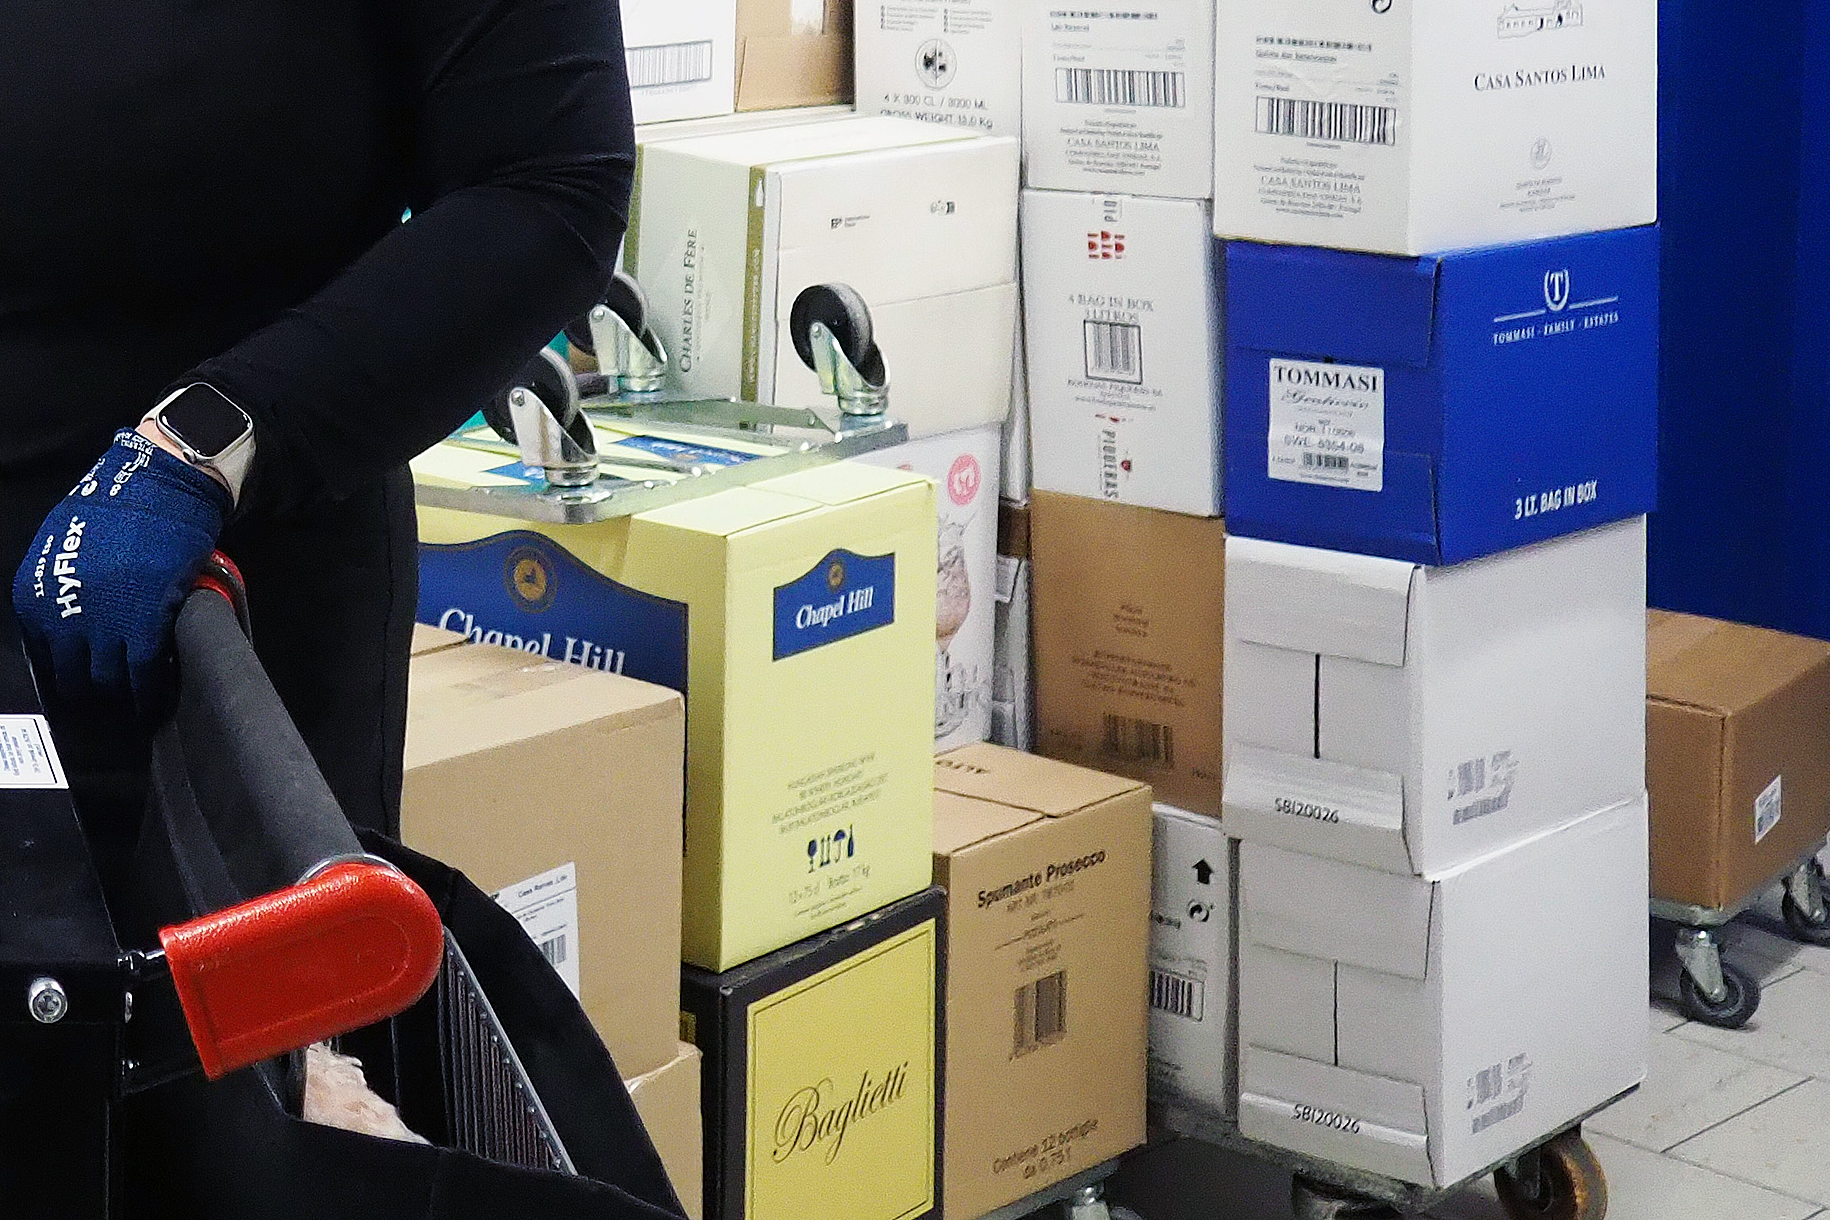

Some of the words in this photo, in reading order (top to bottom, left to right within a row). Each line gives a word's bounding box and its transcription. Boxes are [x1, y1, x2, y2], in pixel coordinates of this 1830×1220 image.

[1474, 70, 1512, 93] CASA
[1514, 66, 1567, 90] SANTOS
[1570, 62, 1607, 84] LIMA
[684, 273, 695, 294] DE
[680, 298, 693, 372] CHARLES
[1493, 325, 1536, 345] TOMMASI
[1274, 364, 1378, 393] TOMMASI
[1515, 499, 1523, 520] 3
[1525, 495, 1538, 517] LT.
[1540, 491, 1561, 513] BAG
[1564, 487, 1574, 508] IN
[1576, 481, 1598, 505] BOX
[53, 516, 86, 619] HyFlex
[795, 595, 844, 631] Chapel
[846, 586, 874, 613] Hill
[1274, 796, 1340, 825] SBI20026
[977, 872, 1043, 909] Spumante
[1046, 849, 1107, 882] Prosecco
[772, 1060, 910, 1166] Baglietti
[1293, 1103, 1362, 1135] SBI20026
